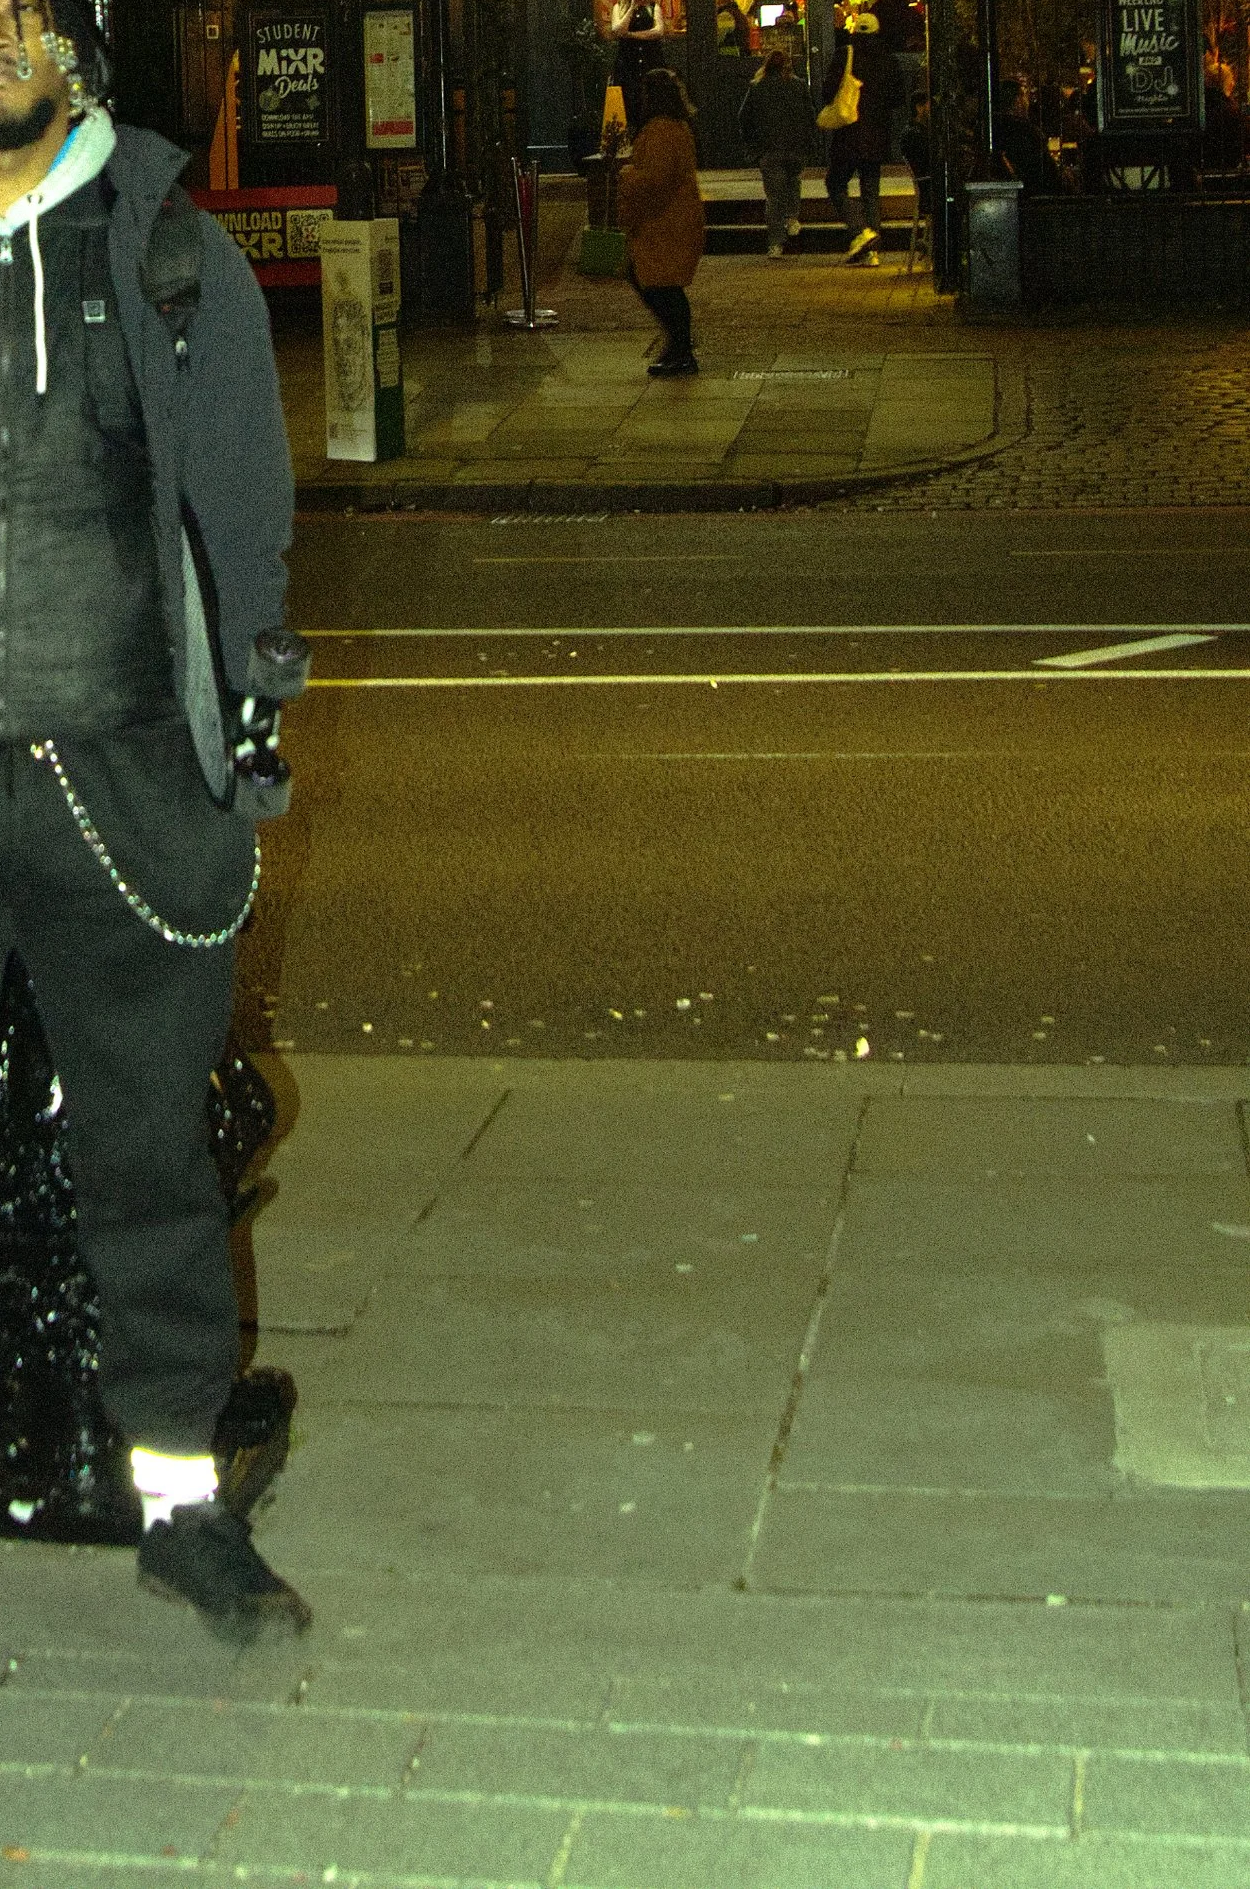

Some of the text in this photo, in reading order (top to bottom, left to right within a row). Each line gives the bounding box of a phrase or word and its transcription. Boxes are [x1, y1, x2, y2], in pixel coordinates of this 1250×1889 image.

[1121, 8, 1165, 32] LIVE
[256, 23, 320, 44] STUDENT
[1119, 33, 1180, 57] Music
[274, 75, 319, 99] Deals
[1130, 65, 1174, 93] DJ
[217, 211, 282, 231] WNLOAD
[234, 231, 284, 259] XR
